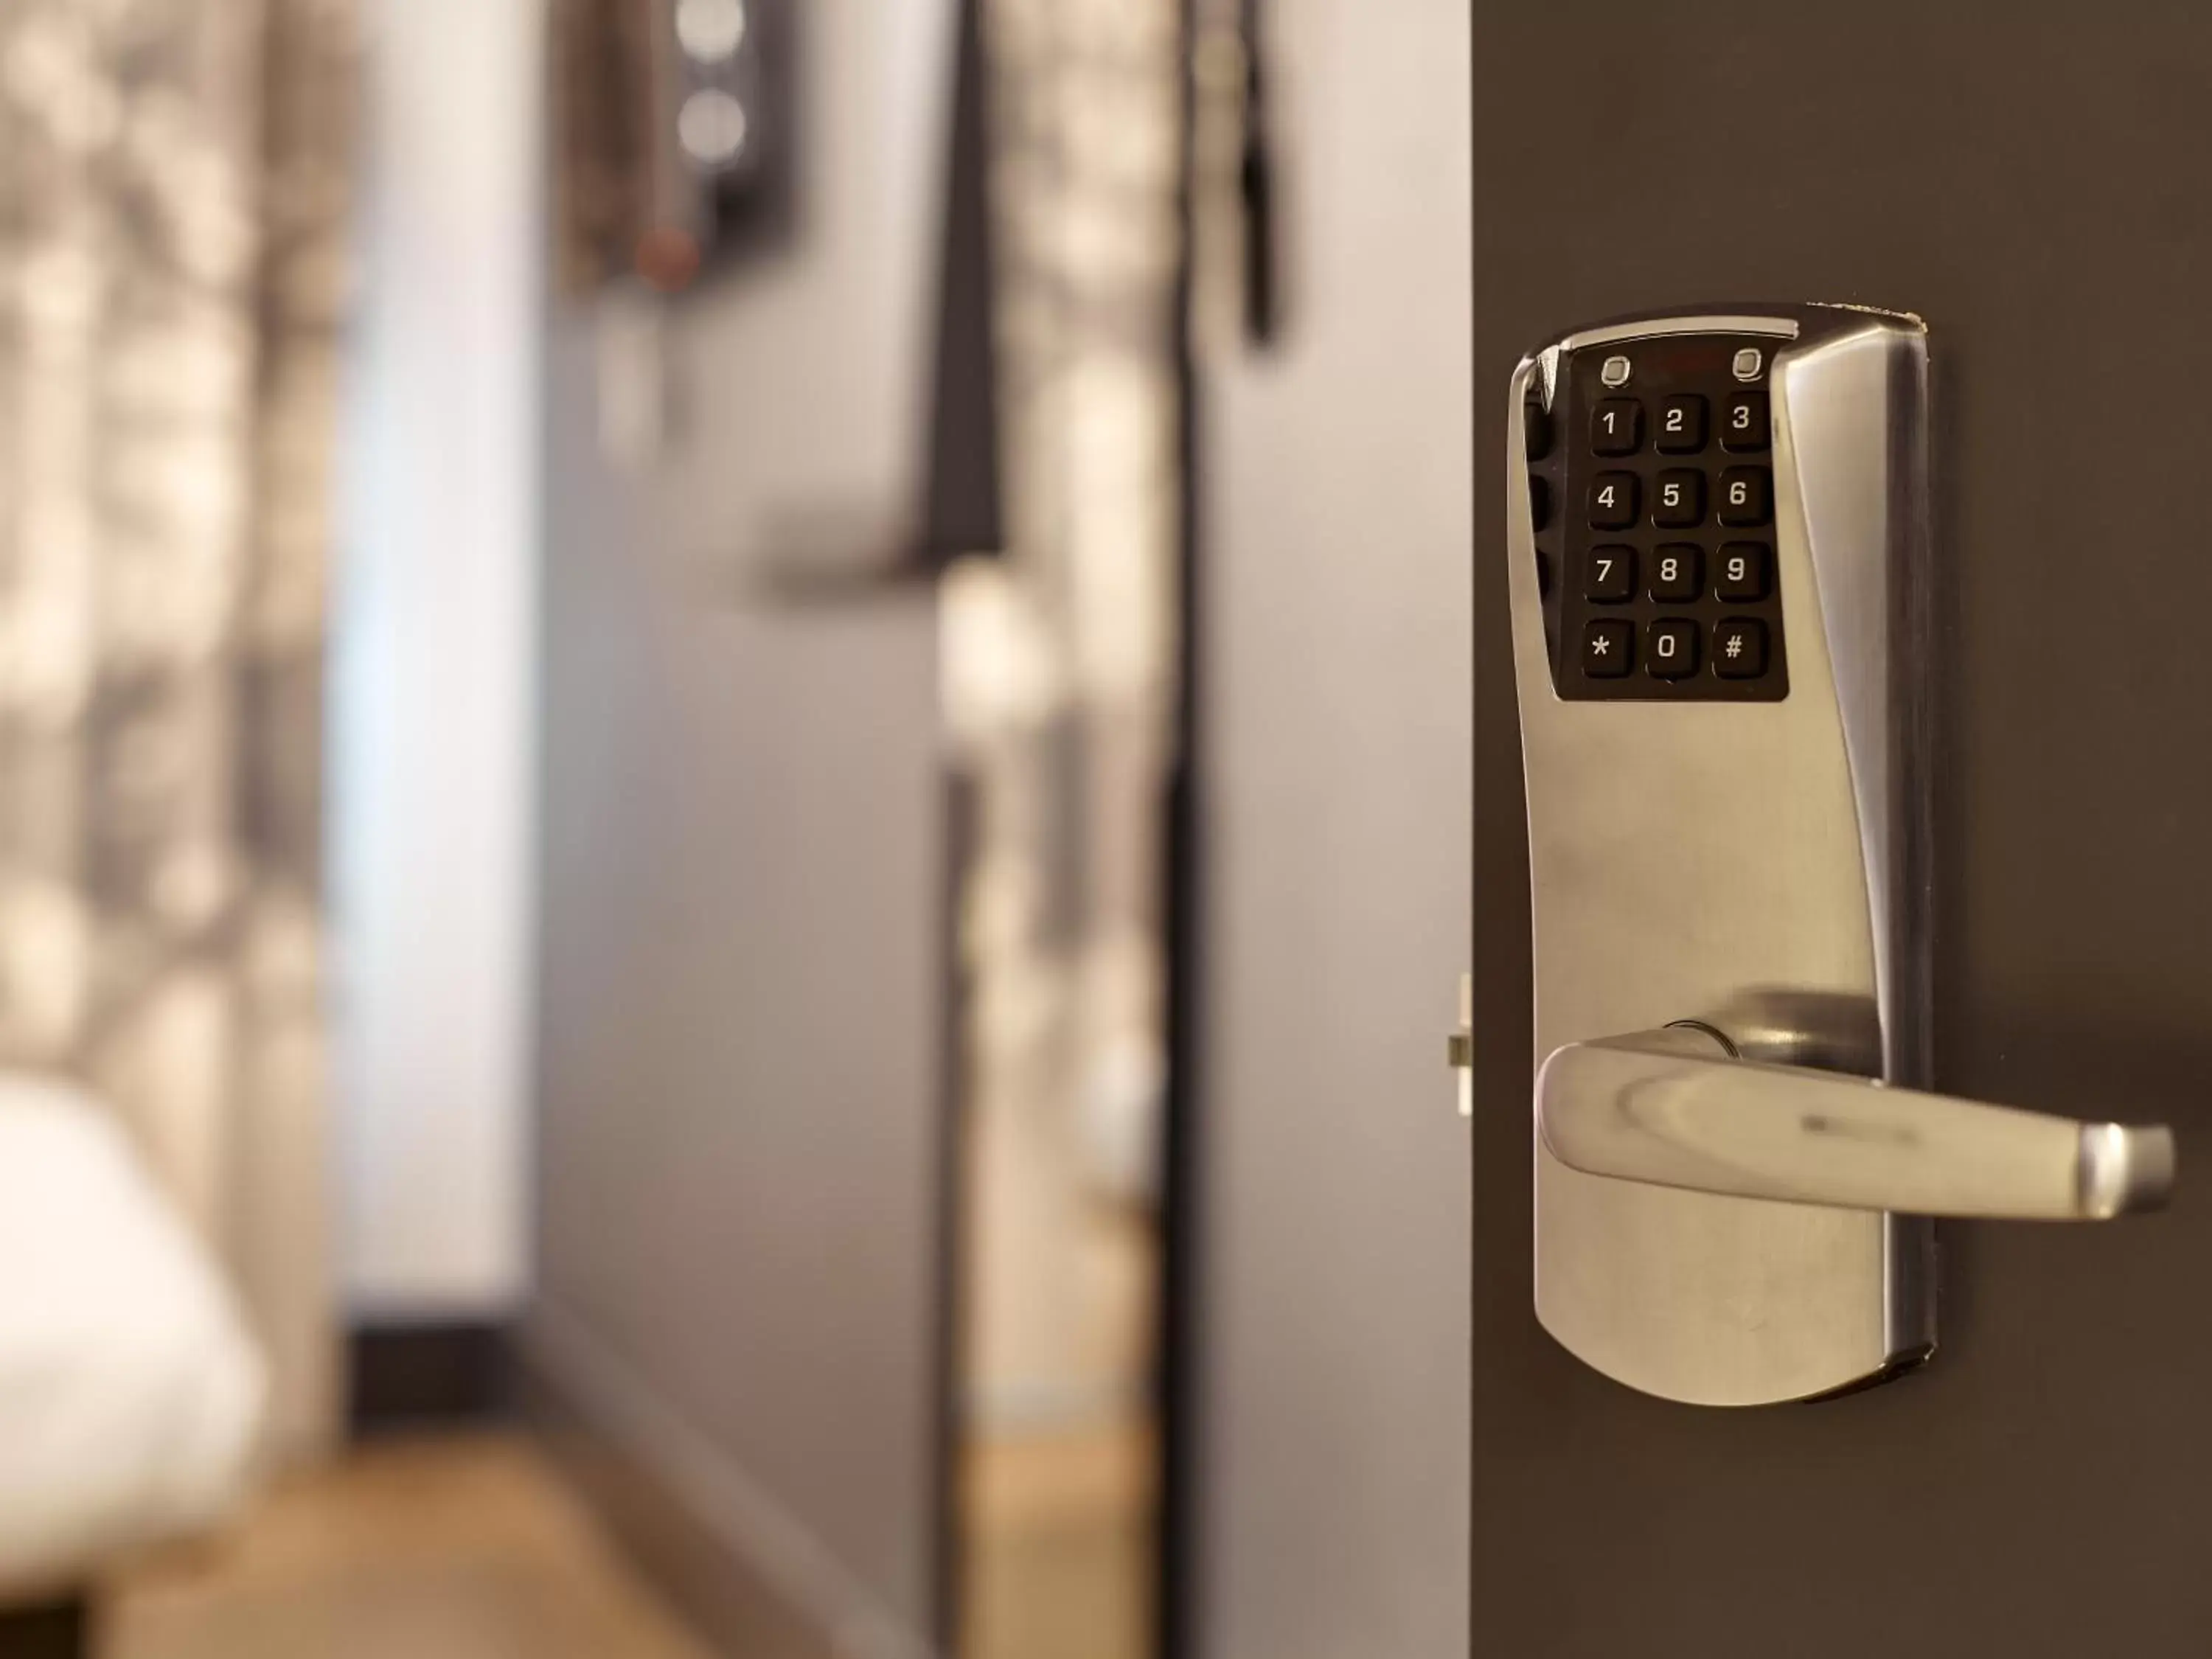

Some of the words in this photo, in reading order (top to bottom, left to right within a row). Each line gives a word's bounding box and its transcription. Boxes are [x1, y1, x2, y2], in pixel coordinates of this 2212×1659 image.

[1602, 412, 1615, 434] 1
[1666, 408, 1683, 431] 2
[1732, 406, 1749, 428] 3
[1598, 485, 1615, 508] 4
[1663, 483, 1680, 507] 5
[1729, 481, 1746, 505] 6
[1596, 560, 1613, 582] 7
[1660, 558, 1677, 582] 8
[1728, 557, 1745, 581] 9
[1658, 635, 1675, 657] 0
[1725, 635, 1742, 658] #
